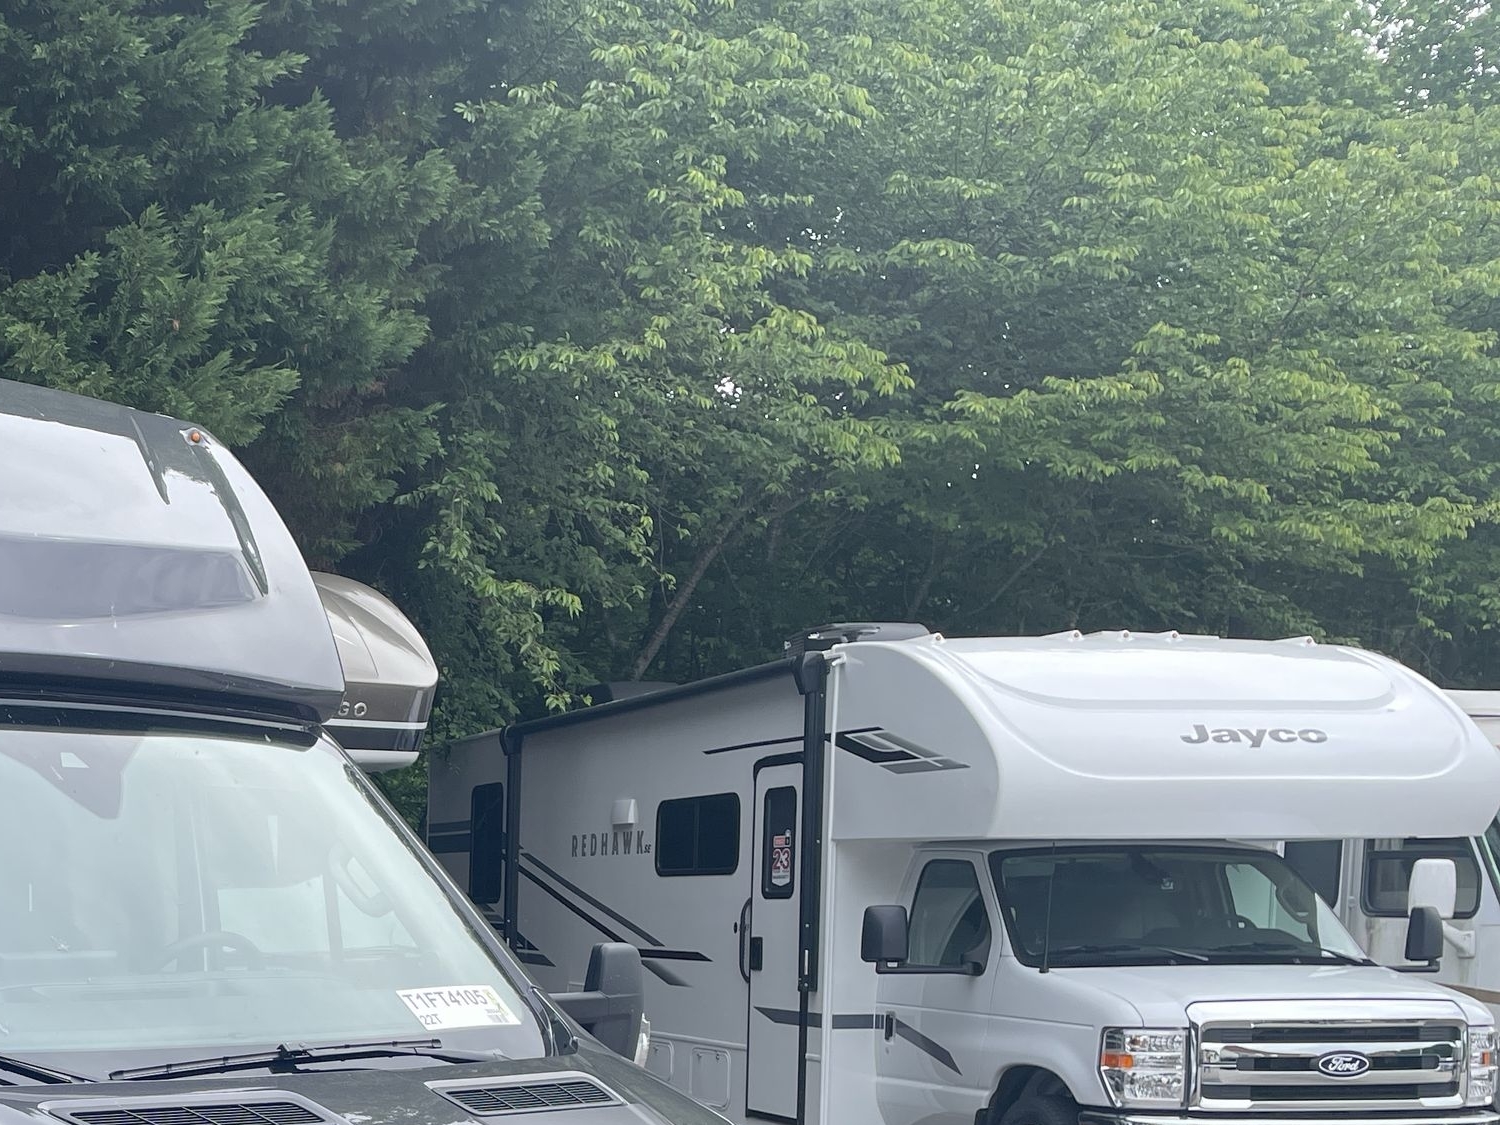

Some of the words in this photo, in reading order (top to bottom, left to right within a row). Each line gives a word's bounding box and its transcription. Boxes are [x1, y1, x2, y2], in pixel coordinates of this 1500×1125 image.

[1180, 724, 1328, 748] Jayco
[572, 830, 644, 857] REDHAWK
[402, 990, 488, 1010] T1FT4105
[420, 1013, 443, 1026] 22T
[1328, 1056, 1360, 1071] Ford
